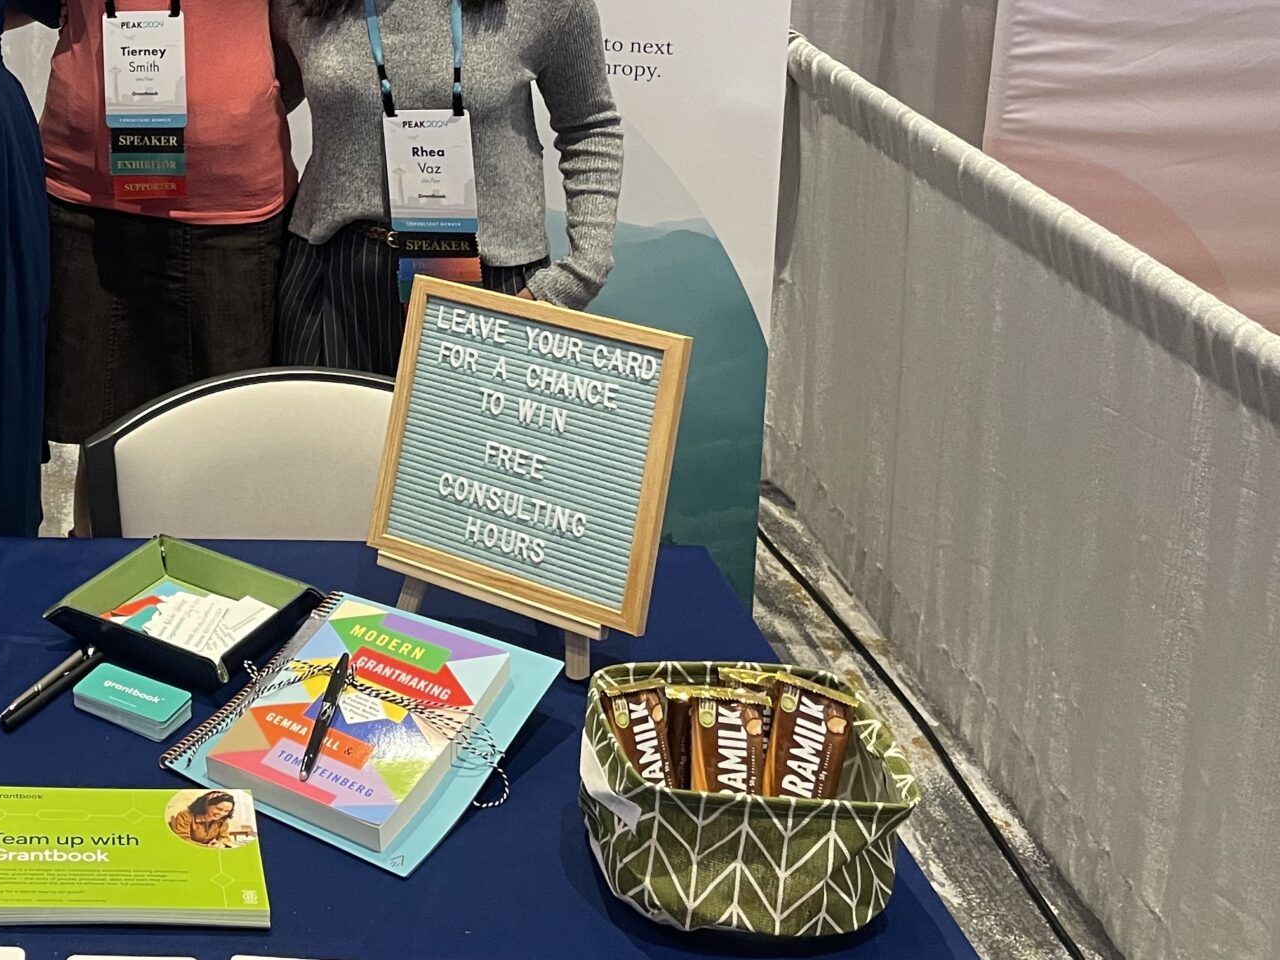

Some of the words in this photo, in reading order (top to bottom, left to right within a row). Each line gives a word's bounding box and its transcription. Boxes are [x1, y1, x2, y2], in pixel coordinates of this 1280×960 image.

[120, 46, 167, 59] Tierney
[604, 38, 623, 52] to
[630, 41, 674, 56] next
[129, 60, 160, 73] Smith
[118, 135, 178, 146] SPEAKER
[411, 146, 445, 157] Rhea
[117, 160, 177, 170] EXHIBITOR
[417, 162, 442, 174] Vaz
[405, 240, 470, 251] SPEAKER
[436, 305, 510, 344] LEAVE
[525, 325, 582, 363] YOUR
[592, 344, 657, 382] CARD
[437, 341, 479, 372] FOR
[492, 356, 508, 380] A
[525, 365, 620, 411] CHANCE
[479, 387, 505, 416] TO
[518, 398, 568, 434] WIN
[483, 440, 548, 480] FREE
[438, 472, 587, 538] CONSULTING
[465, 516, 545, 563] HOURS
[350, 624, 426, 660] MODERN
[356, 655, 452, 700] GRANTMAKING
[265, 712, 309, 736] GEMMA
[344, 746, 353, 756] &
[779, 695, 827, 799] RAMILK
[312, 765, 374, 798] TEINBERG
[56, 834, 84, 849] up
[90, 832, 140, 846] with
